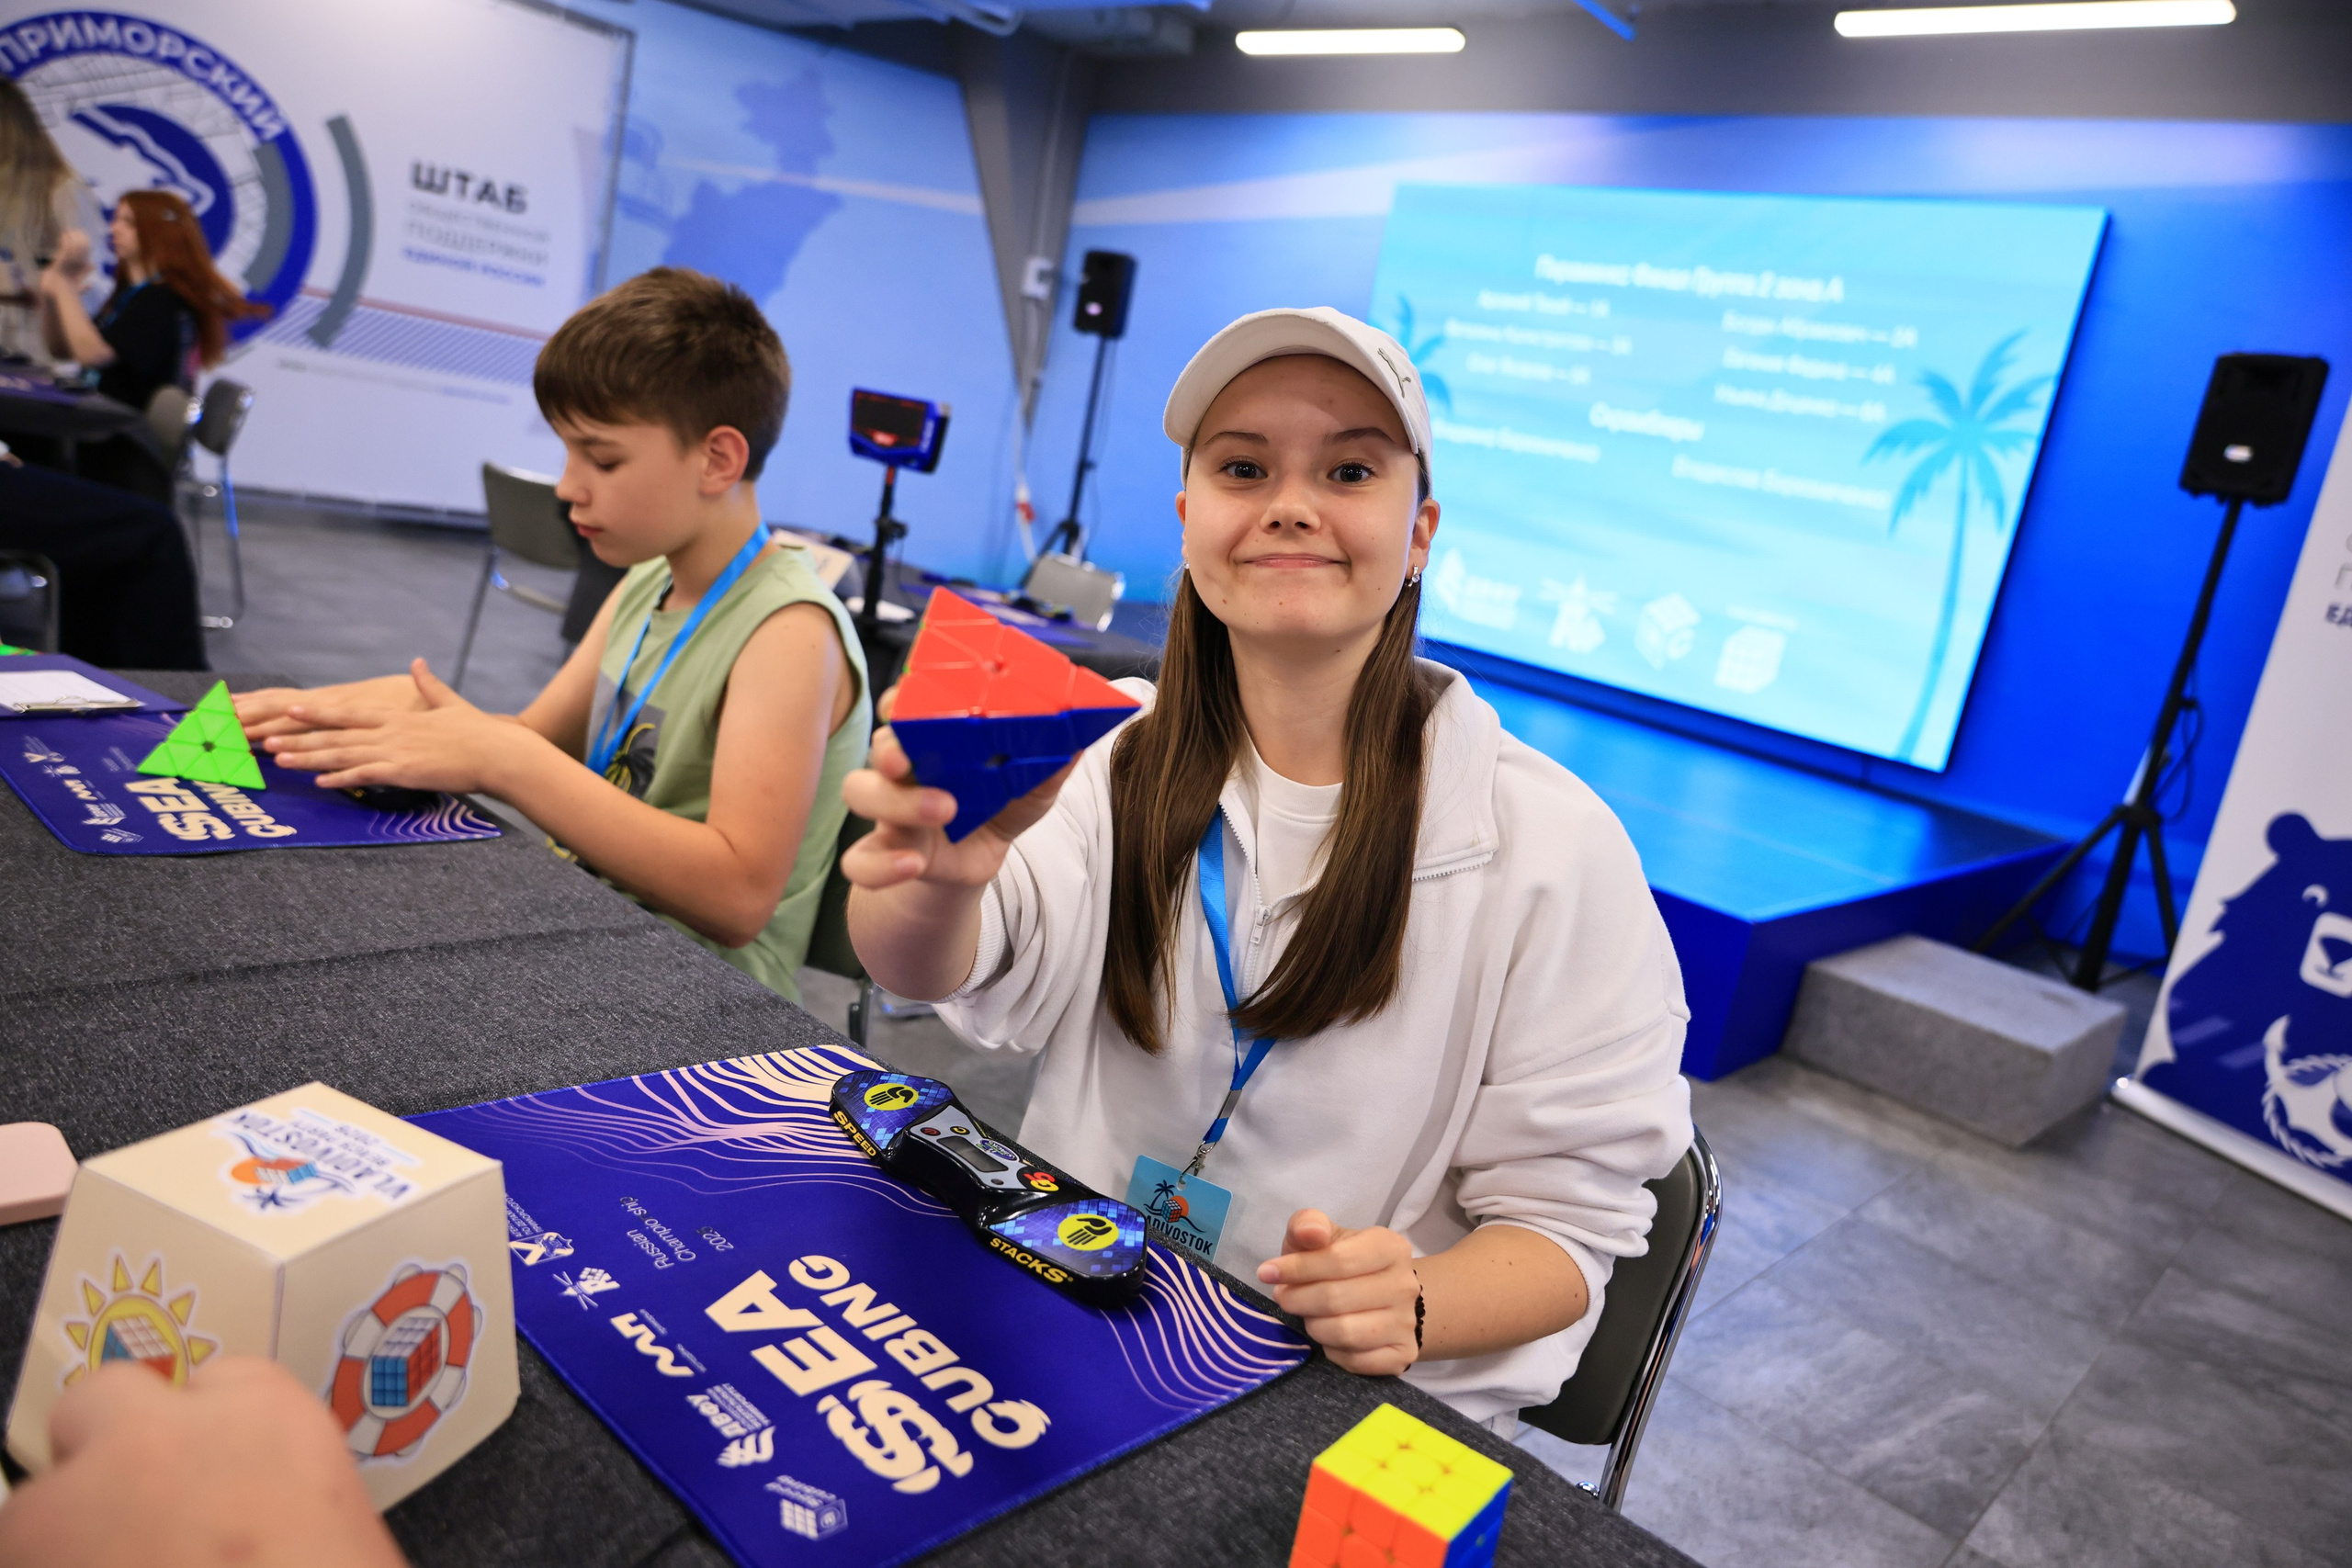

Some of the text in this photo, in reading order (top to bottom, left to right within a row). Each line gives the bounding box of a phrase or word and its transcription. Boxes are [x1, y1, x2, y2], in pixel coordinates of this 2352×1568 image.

[0, 13, 286, 141] ПРИМОРСКИЙ
[413, 163, 528, 214] ШТАБ
[125, 777, 235, 841] SEA
[833, 1111, 876, 1157] SPEED
[627, 1229, 674, 1269] Russian
[695, 1226, 734, 1251] 2025
[1147, 1215, 1214, 1256] ADIVOSTOK
[990, 1237, 1067, 1283] STACKS
[788, 1255, 1051, 1449] CUBING
[705, 1269, 974, 1495] SEA
[685, 1394, 748, 1438] ДВФУ
